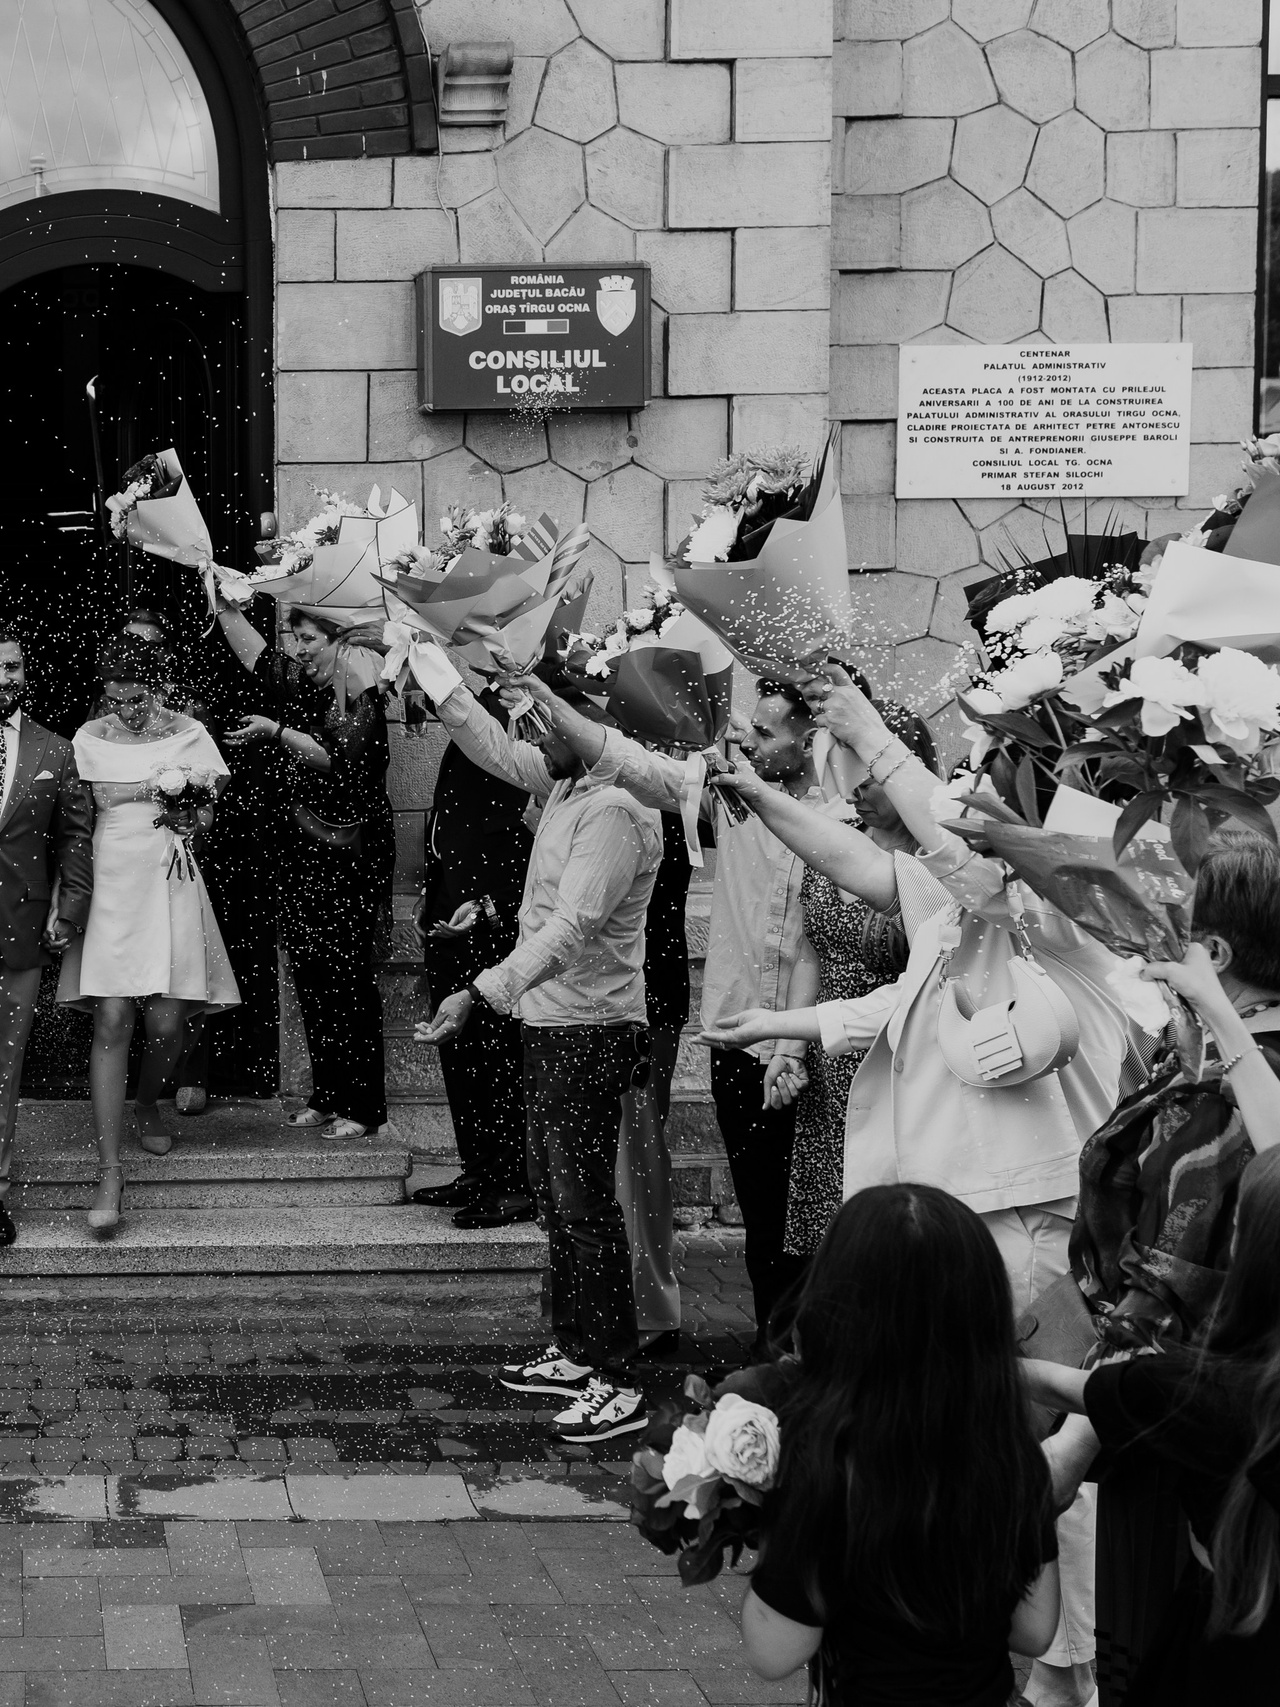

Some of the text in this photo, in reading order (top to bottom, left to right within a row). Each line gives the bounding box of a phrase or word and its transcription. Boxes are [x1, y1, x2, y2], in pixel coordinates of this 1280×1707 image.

[510, 273, 565, 285] ROMÂNIA
[545, 286, 586, 298] BACĂU
[518, 302, 555, 313] TÎRGU
[557, 303, 591, 313] OCNA
[1019, 350, 1071, 358] CENTENAR
[468, 349, 607, 370] CONSILIUL
[1031, 362, 1107, 370] ADMINISTRATIV
[1017, 374, 1072, 383] (1912-2012)
[496, 374, 580, 394] LOCAL
[922, 387, 966, 395] ACEASTA
[971, 387, 1002, 395] PLACA
[1050, 386, 1097, 394] MONTATA
[1102, 386, 1116, 394] CU
[918, 399, 979, 407] ANIVERSARII
[985, 399, 992, 407] A
[998, 399, 1014, 407] 100
[1060, 398, 1072, 406] DE
[1078, 398, 1090, 406] LA
[1095, 398, 1163, 406] CONSTRUIREA
[965, 411, 1039, 419] ADMINISTRATIV
[1062, 410, 1111, 418] ORASULUI
[1151, 410, 1181, 418] OCNA,
[906, 424, 947, 432] CLADIRE
[950, 423, 1011, 431] PROIECTATA
[1015, 423, 1027, 431] DE
[1086, 422, 1116, 430] PETRE
[908, 436, 918, 444] SI
[923, 435, 985, 444] CONSTRUITA
[990, 435, 1002, 443] DE
[1008, 435, 1085, 443] ANTREPRENORII
[1090, 434, 1136, 442] GIUSEPPE
[999, 447, 1087, 455] SI A. FONDIANER.
[972, 459, 1023, 467] CONSILIUL
[1028, 459, 1059, 467] LOCAL
[1065, 459, 1081, 467] TG.
[981, 471, 1017, 479] PRIMAR
[1023, 471, 1060, 479] STEFAN
[1001, 482, 1084, 491] 18 AUGUST 2012
